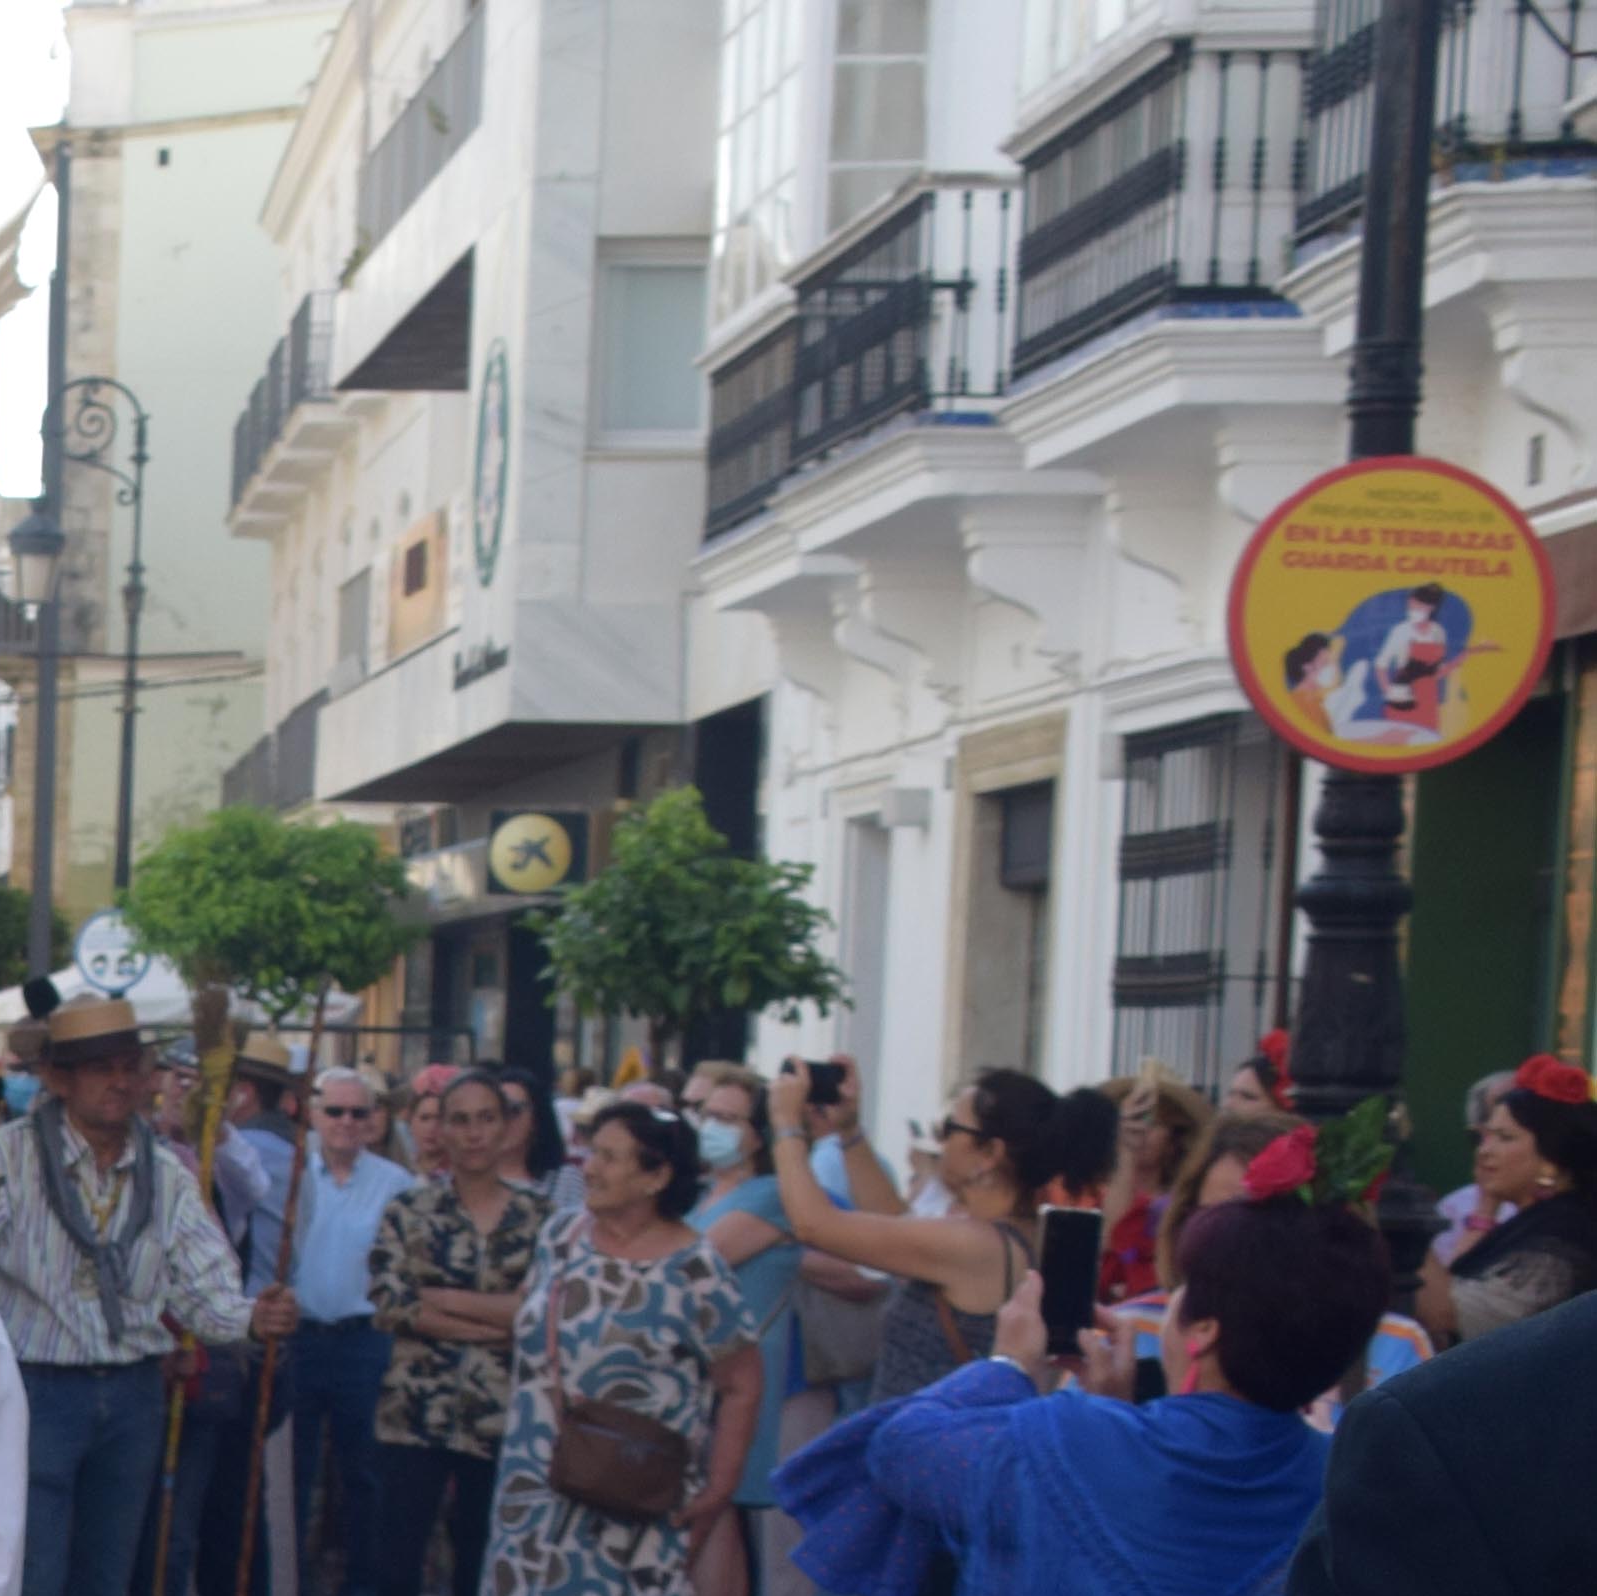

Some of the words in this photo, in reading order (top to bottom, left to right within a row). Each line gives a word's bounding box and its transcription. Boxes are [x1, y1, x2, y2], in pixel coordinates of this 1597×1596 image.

[1285, 525, 1319, 541] EN
[1324, 527, 1372, 545] LAS
[1380, 529, 1515, 550] TERRAZAS
[1282, 551, 1388, 571] GUARDA
[1395, 557, 1512, 576] CAUTELA
